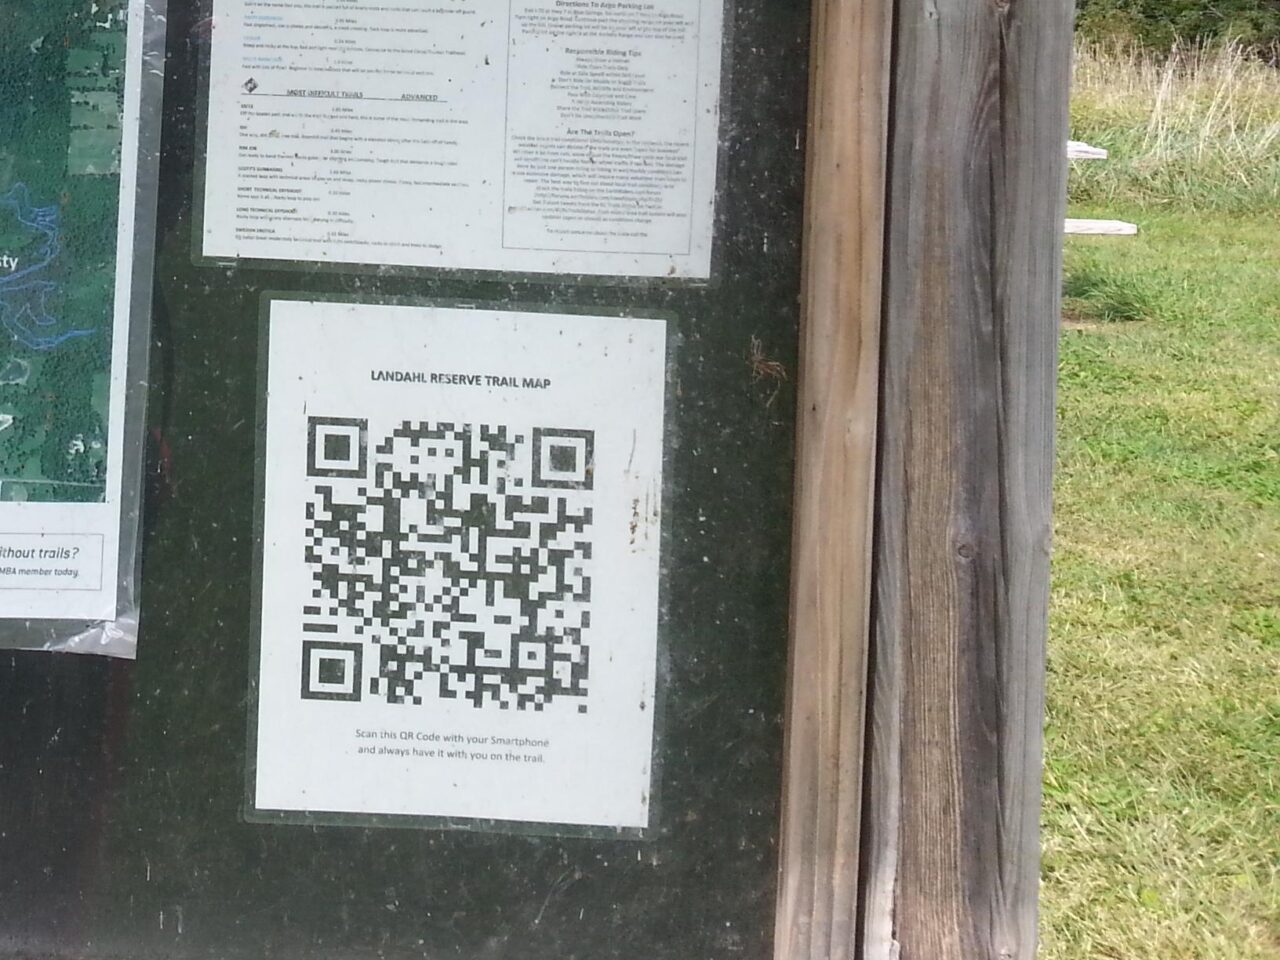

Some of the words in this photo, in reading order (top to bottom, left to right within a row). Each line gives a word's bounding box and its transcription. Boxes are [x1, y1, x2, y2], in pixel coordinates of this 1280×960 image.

[400, 93, 438, 101] ADVANCED
[370, 370, 428, 384] LANDAHL
[430, 373, 482, 387] RESERVE
[484, 375, 520, 389] TRAIL
[521, 377, 551, 390] MAP
[38, 546, 81, 560] trails?
[18, 567, 53, 577] member
[355, 728, 377, 739] Scan
[380, 730, 397, 740] this
[399, 731, 414, 741] QR
[416, 732, 441, 743] Code
[443, 733, 464, 744] with
[466, 736, 489, 746] your
[490, 736, 549, 749] Smartphone
[358, 745, 376, 755] and
[377, 746, 410, 758] always
[412, 747, 436, 758] have
[437, 748, 445, 758] it
[446, 749, 468, 760] with
[469, 752, 488, 762] you
[490, 753, 503, 761] on
[505, 752, 521, 762] the
